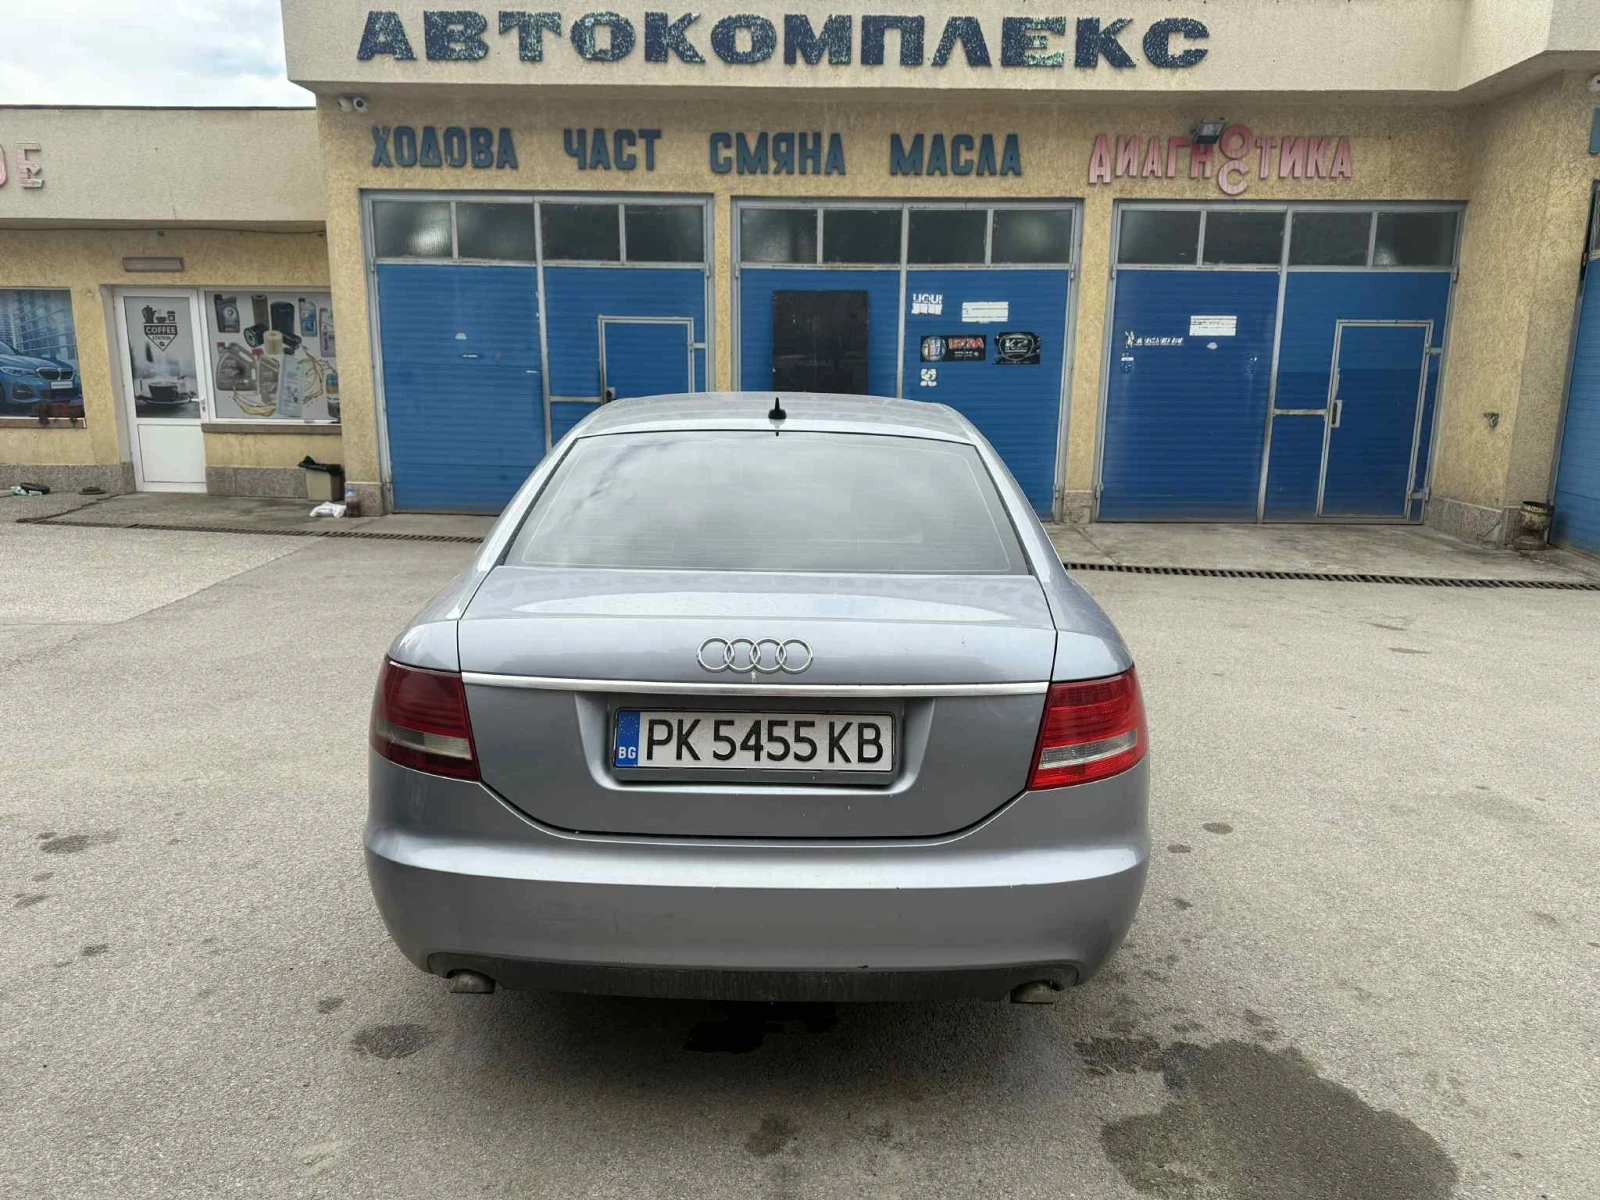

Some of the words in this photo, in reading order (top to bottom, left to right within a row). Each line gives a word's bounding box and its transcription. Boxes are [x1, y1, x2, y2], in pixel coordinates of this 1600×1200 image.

[356, 10, 1210, 69] АВТОКОМПЛЕКС
[371, 125, 519, 170] ХОДОВА
[563, 128, 662, 171] ЧАСТ
[709, 131, 846, 176] СМЯНА
[889, 133, 1022, 176] МАСЛА
[1088, 123, 1352, 196] ДИАГНОСТИКА
[145, 326, 177, 334] COFFEE
[618, 746, 637, 760] BG
[645, 717, 702, 762] PK
[712, 719, 818, 763] 5455
[827, 720, 884, 764] KB
